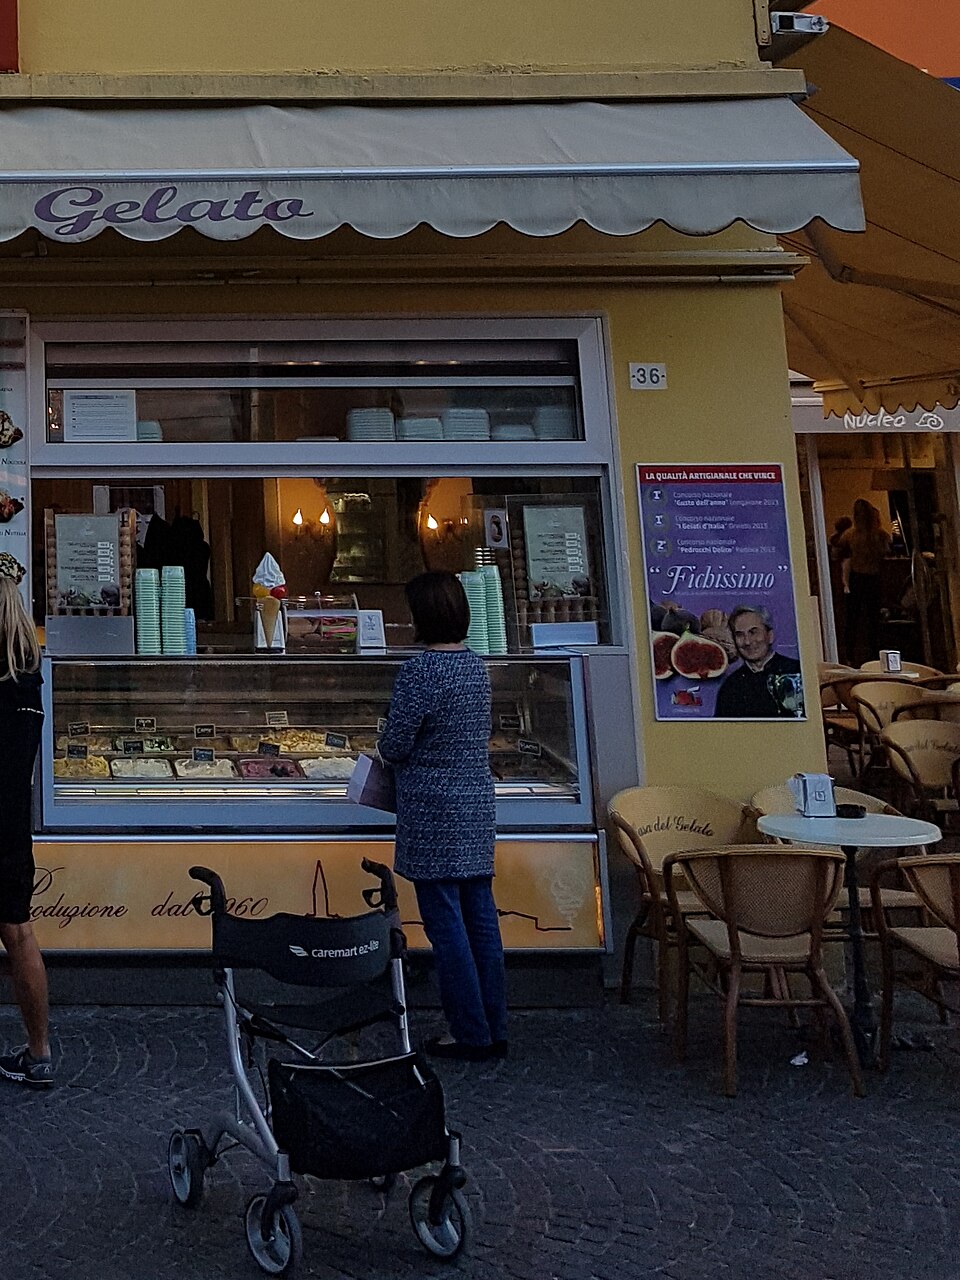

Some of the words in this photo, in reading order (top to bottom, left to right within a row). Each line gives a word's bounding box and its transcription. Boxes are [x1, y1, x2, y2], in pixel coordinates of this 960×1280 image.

[34, 186, 315, 236] Gelato
[843, 406, 906, 429] Nucleo
[646, 472, 656, 480] LA
[656, 470, 688, 481] QUALITÀ
[688, 472, 737, 480] ARTIGIANALE
[738, 472, 753, 480] CHE
[637, 823, 653, 837] asa
[654, 816, 672, 832] del
[673, 815, 715, 837] Gelato
[311, 946, 358, 958] caremart
